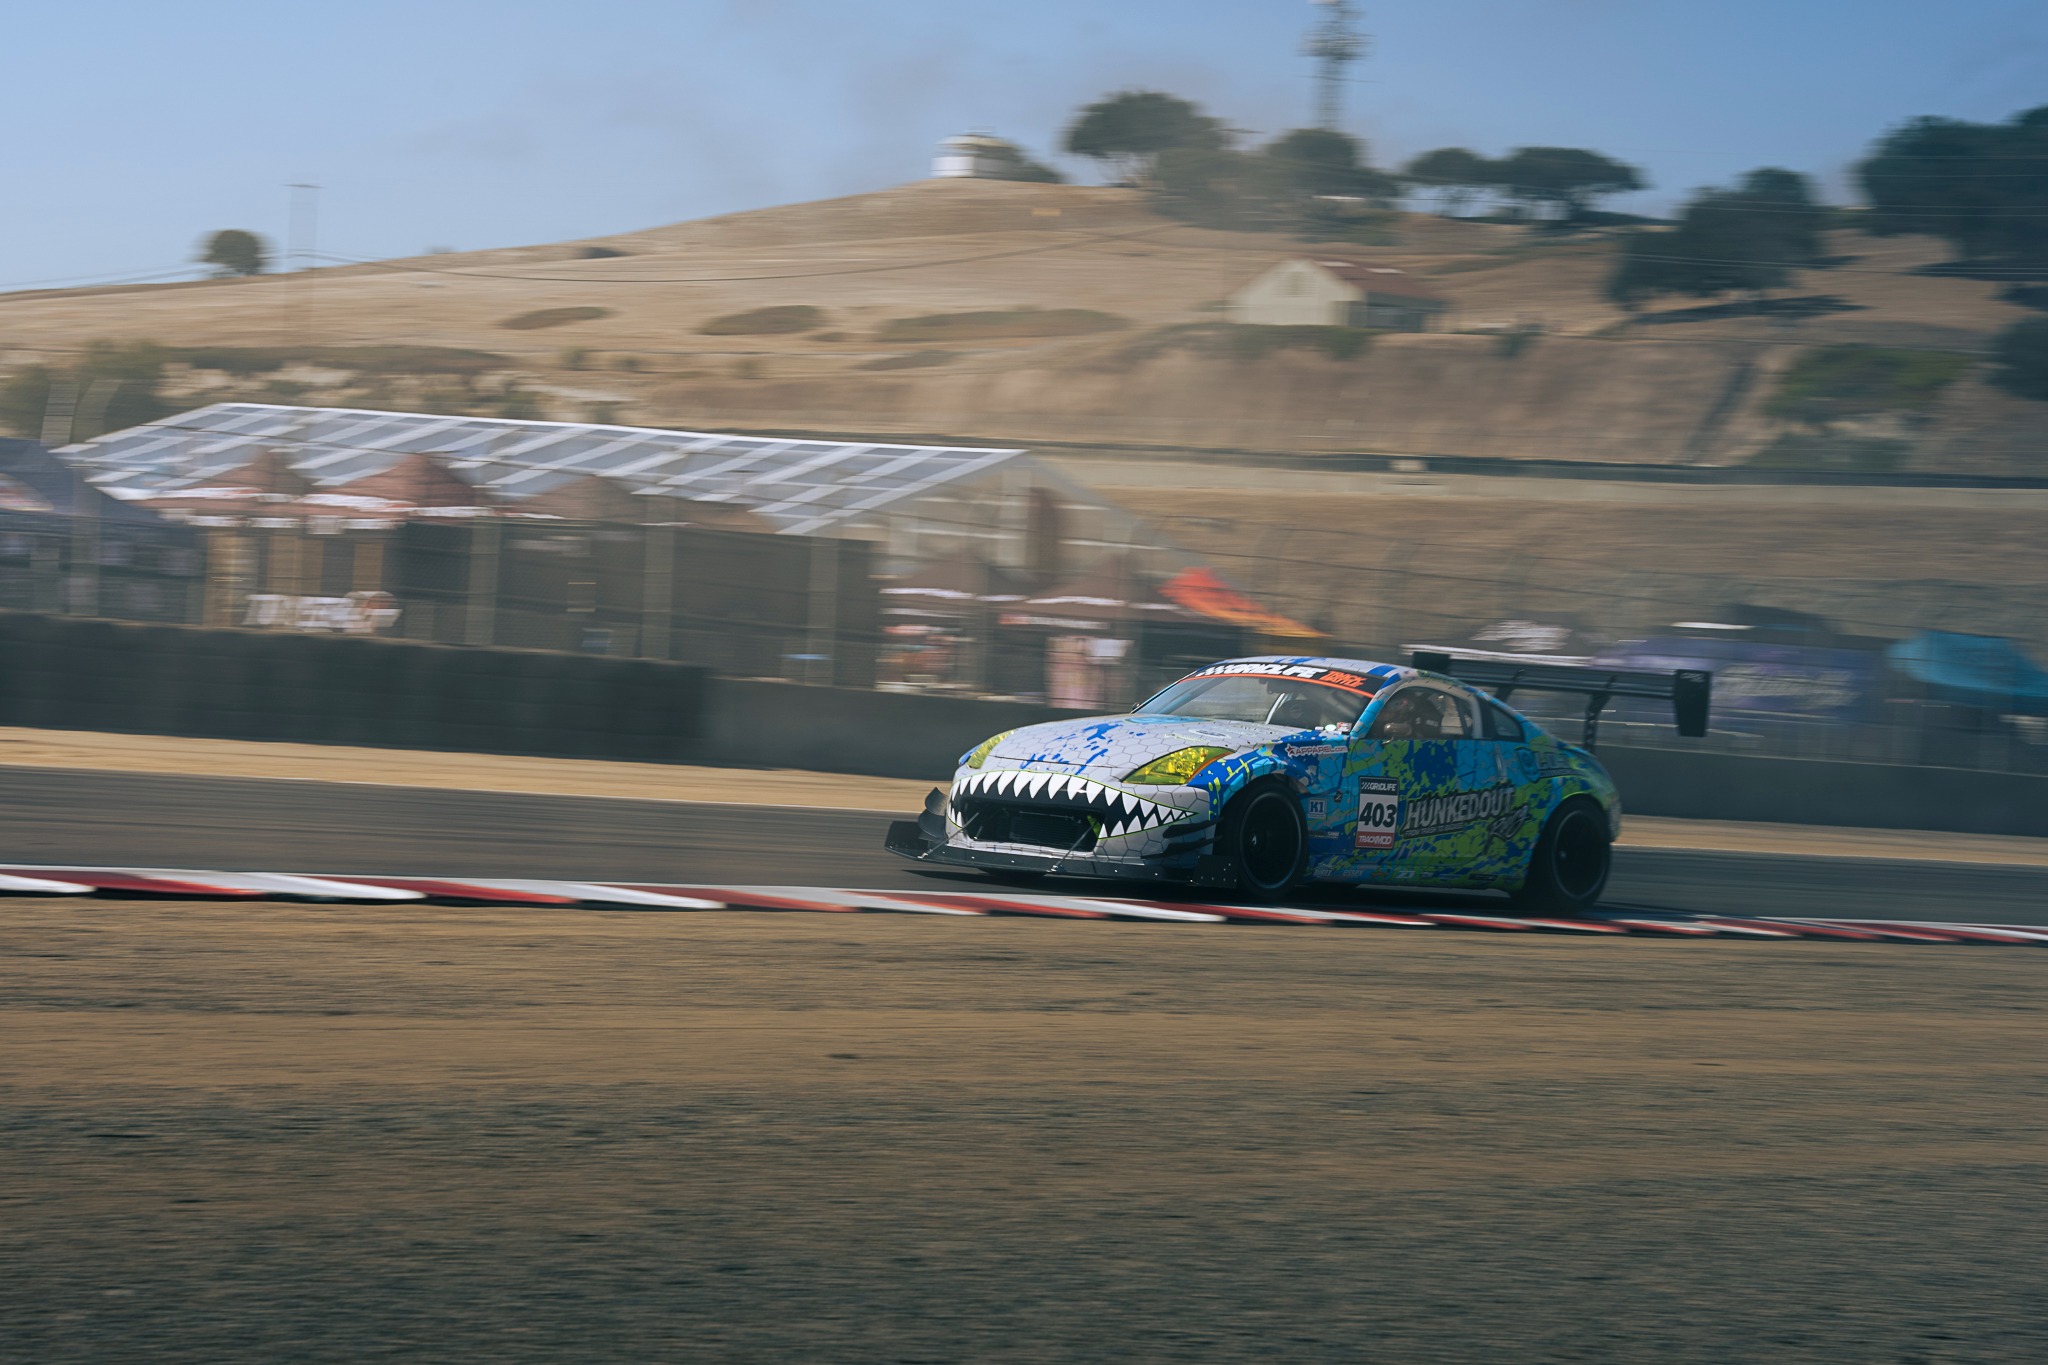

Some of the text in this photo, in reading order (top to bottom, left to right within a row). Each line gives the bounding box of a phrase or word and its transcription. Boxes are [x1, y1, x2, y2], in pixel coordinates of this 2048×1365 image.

[1222, 663, 1328, 678] GRIDLIFE
[1369, 782, 1397, 792] GRIDLIFE
[1310, 801, 1324, 813] K1
[1405, 787, 1514, 828] HUNKEDOUT
[1359, 802, 1397, 828] 403
